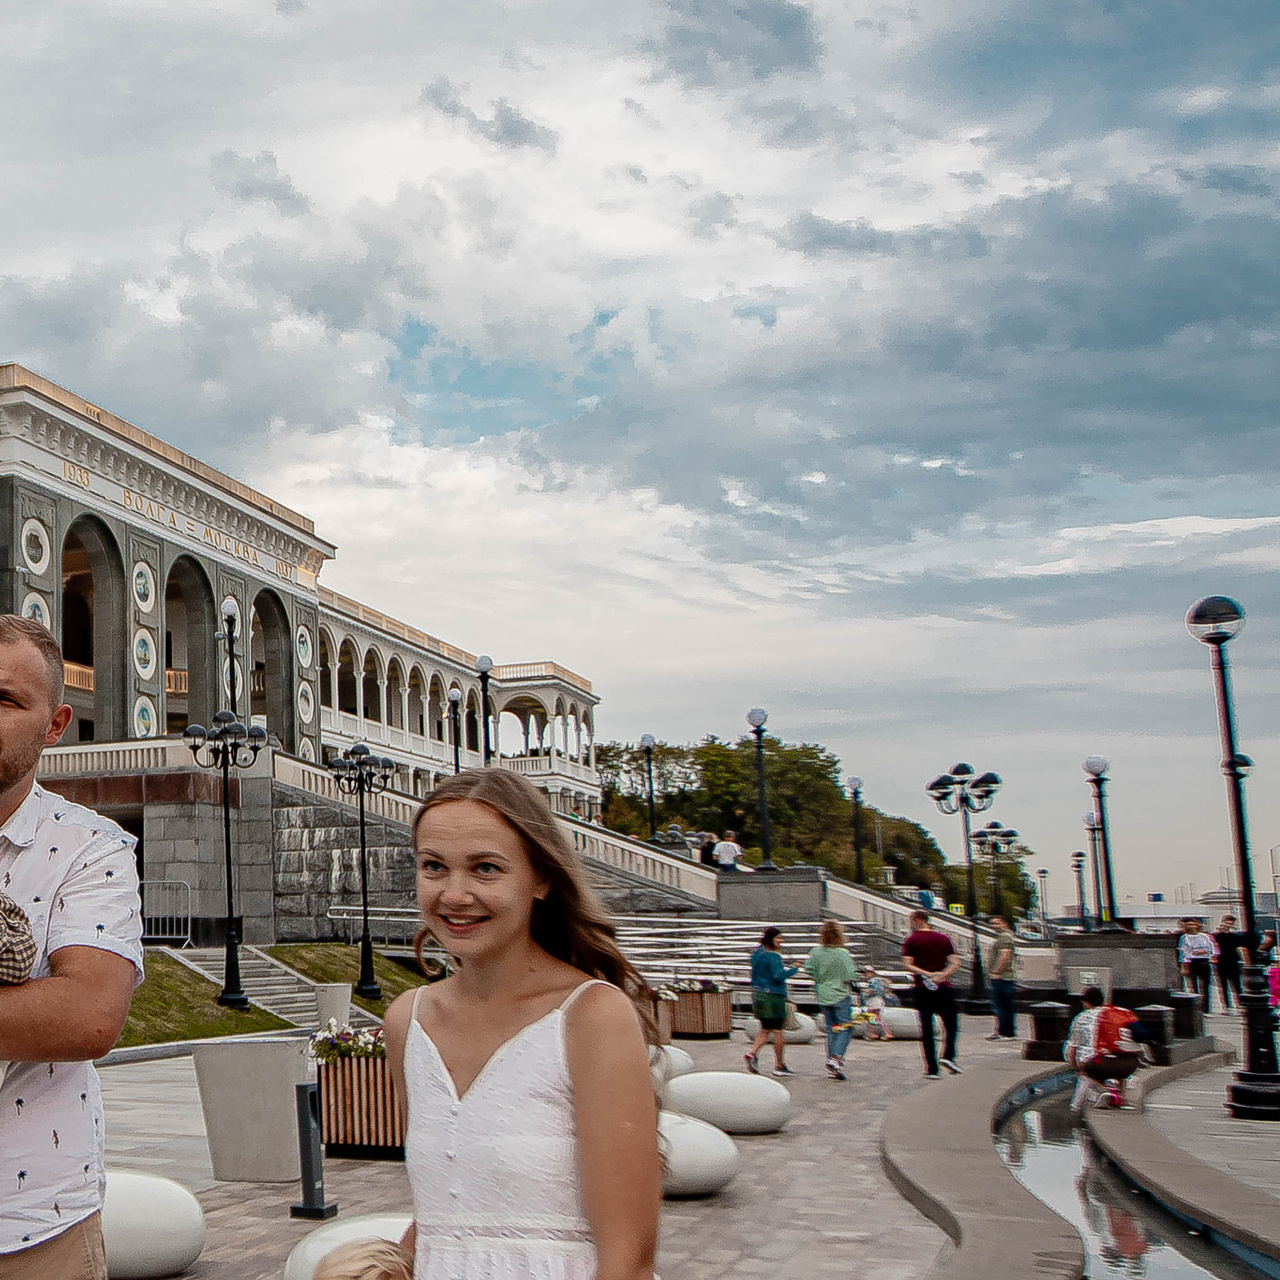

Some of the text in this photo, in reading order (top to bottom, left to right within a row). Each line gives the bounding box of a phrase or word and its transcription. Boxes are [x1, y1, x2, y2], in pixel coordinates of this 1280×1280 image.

[63, 461, 91, 487] 1933
[123, 488, 177, 528] ВОЛГА
[203, 526, 259, 564] МОСКВА
